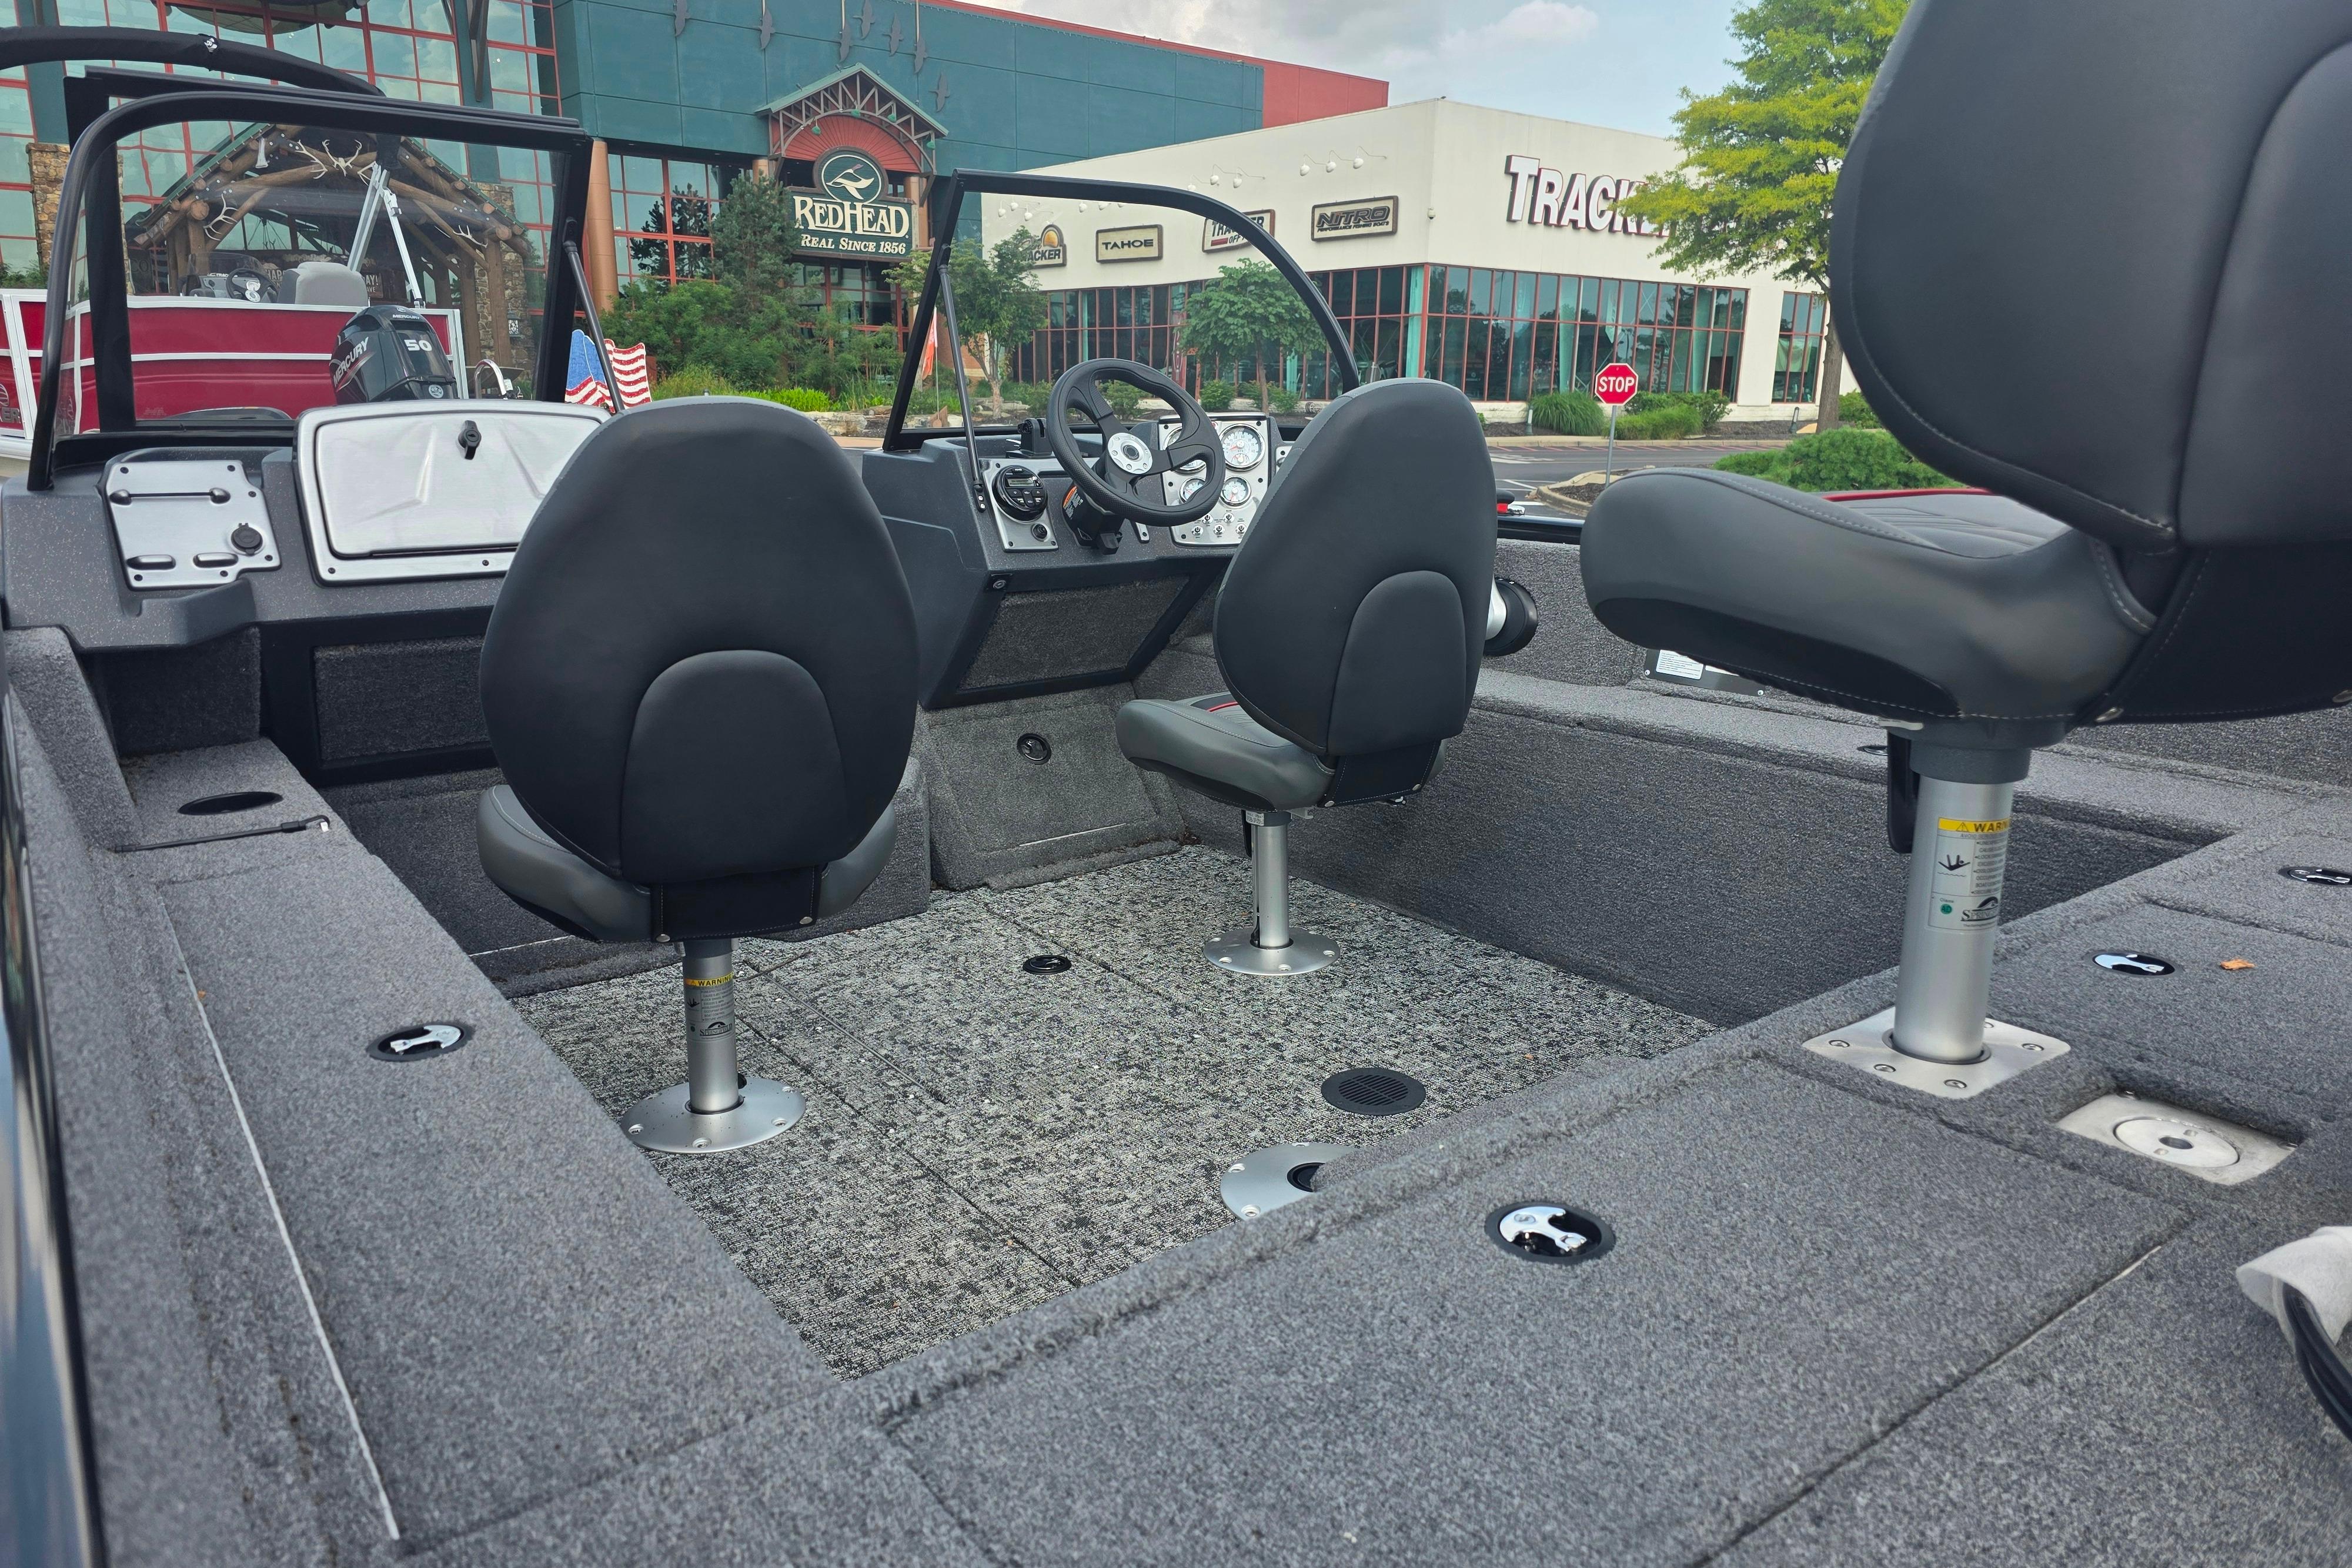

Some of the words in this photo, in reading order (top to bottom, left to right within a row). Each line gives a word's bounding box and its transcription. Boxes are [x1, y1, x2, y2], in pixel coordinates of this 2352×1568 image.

[1504, 155, 1677, 237] TRACK
[793, 196, 909, 238] REDHEAD
[1316, 206, 1390, 228] NITRO
[801, 234, 835, 249] REAL
[839, 238, 876, 252] SINCE
[879, 241, 906, 254] 1856
[1102, 239, 1154, 250] TAHOE
[404, 339, 432, 352] 50
[333, 336, 369, 386] MERCURY
[1599, 377, 1634, 392] STOP
[698, 974, 731, 986] WARNING
